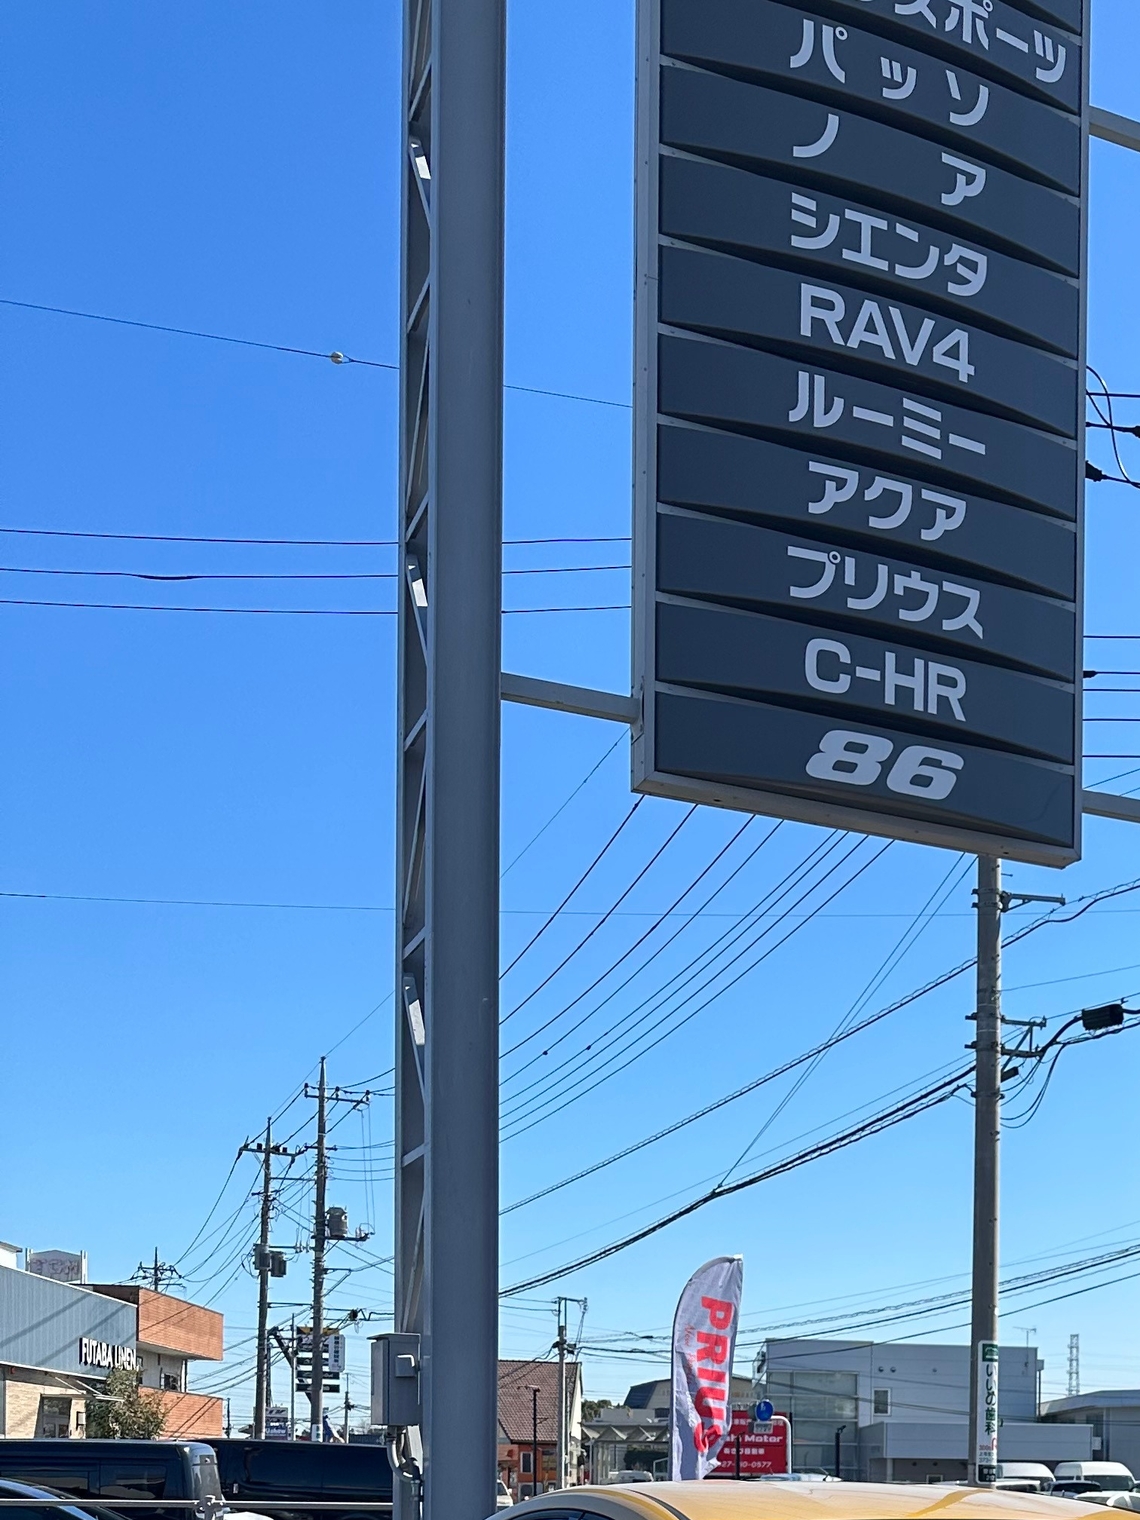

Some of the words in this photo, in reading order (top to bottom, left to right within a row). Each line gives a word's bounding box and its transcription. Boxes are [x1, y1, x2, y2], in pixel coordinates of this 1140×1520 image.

[790, 18, 990, 127] パッソ
[848, 0, 1067, 83] スポーツ
[793, 113, 987, 206] ノア
[791, 192, 988, 297] シエンタ
[801, 283, 975, 383] RAV4
[788, 371, 986, 460] ルーミー
[807, 461, 967, 541] アクア
[787, 546, 984, 639] プリウス
[804, 638, 967, 721] C-HR
[805, 730, 965, 800] 86
[81, 1337, 114, 1369] FUTABA
[744, 1434, 784, 1443] Motor
